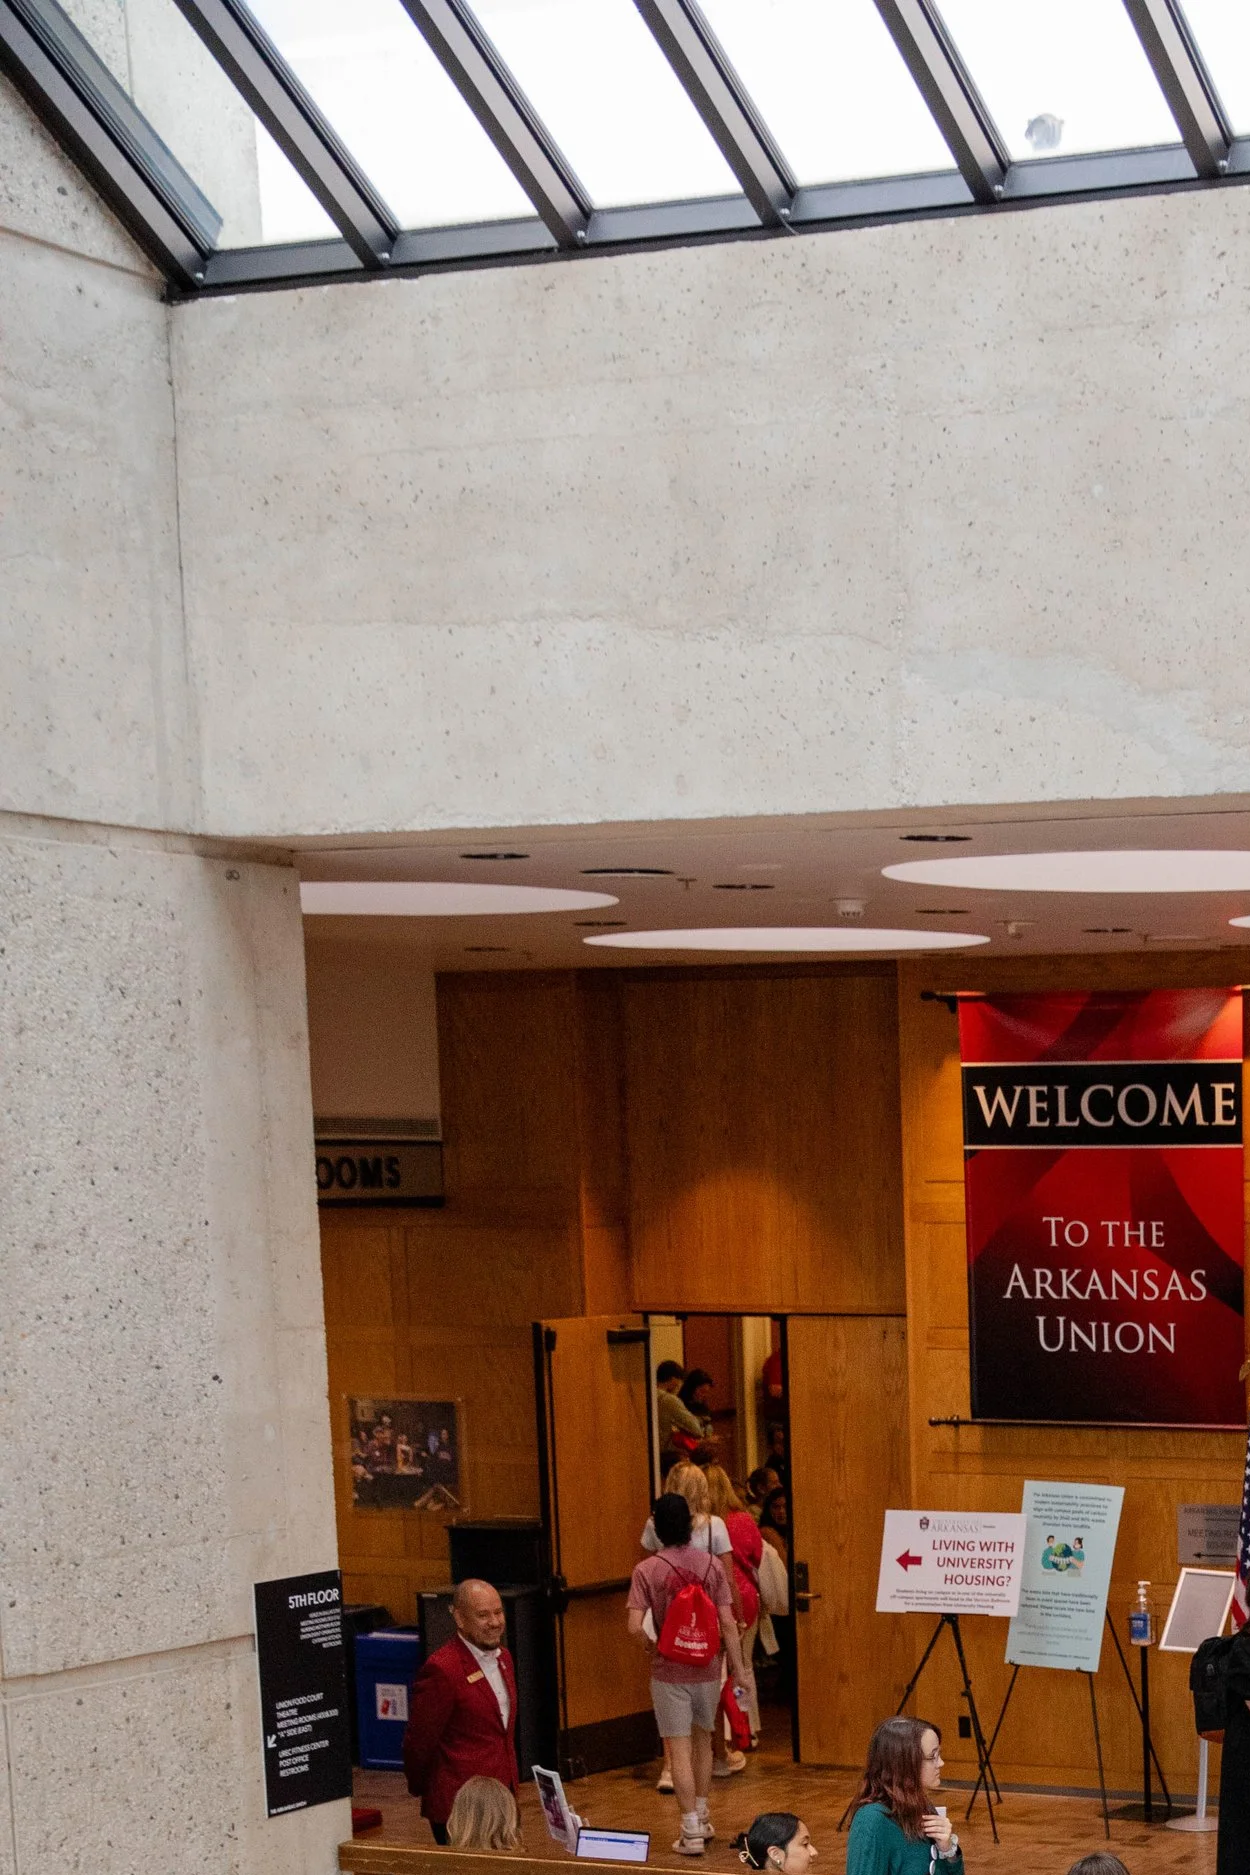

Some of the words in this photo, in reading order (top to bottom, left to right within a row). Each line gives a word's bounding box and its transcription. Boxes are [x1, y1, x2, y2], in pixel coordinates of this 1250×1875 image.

[973, 1083, 1236, 1128] WELCOME
[1100, 1221, 1165, 1248] THE
[1002, 1263, 1207, 1301] ARKANSAS
[1035, 1316, 1176, 1354] UNION
[932, 1540, 975, 1552] LIVING
[980, 1541, 1014, 1552] WITH
[936, 1557, 1014, 1570] UNIVERSITY
[944, 1574, 1012, 1587] HOUSING?
[288, 1594, 307, 1609] 5TH
[308, 1588, 340, 1606] FLOOR
